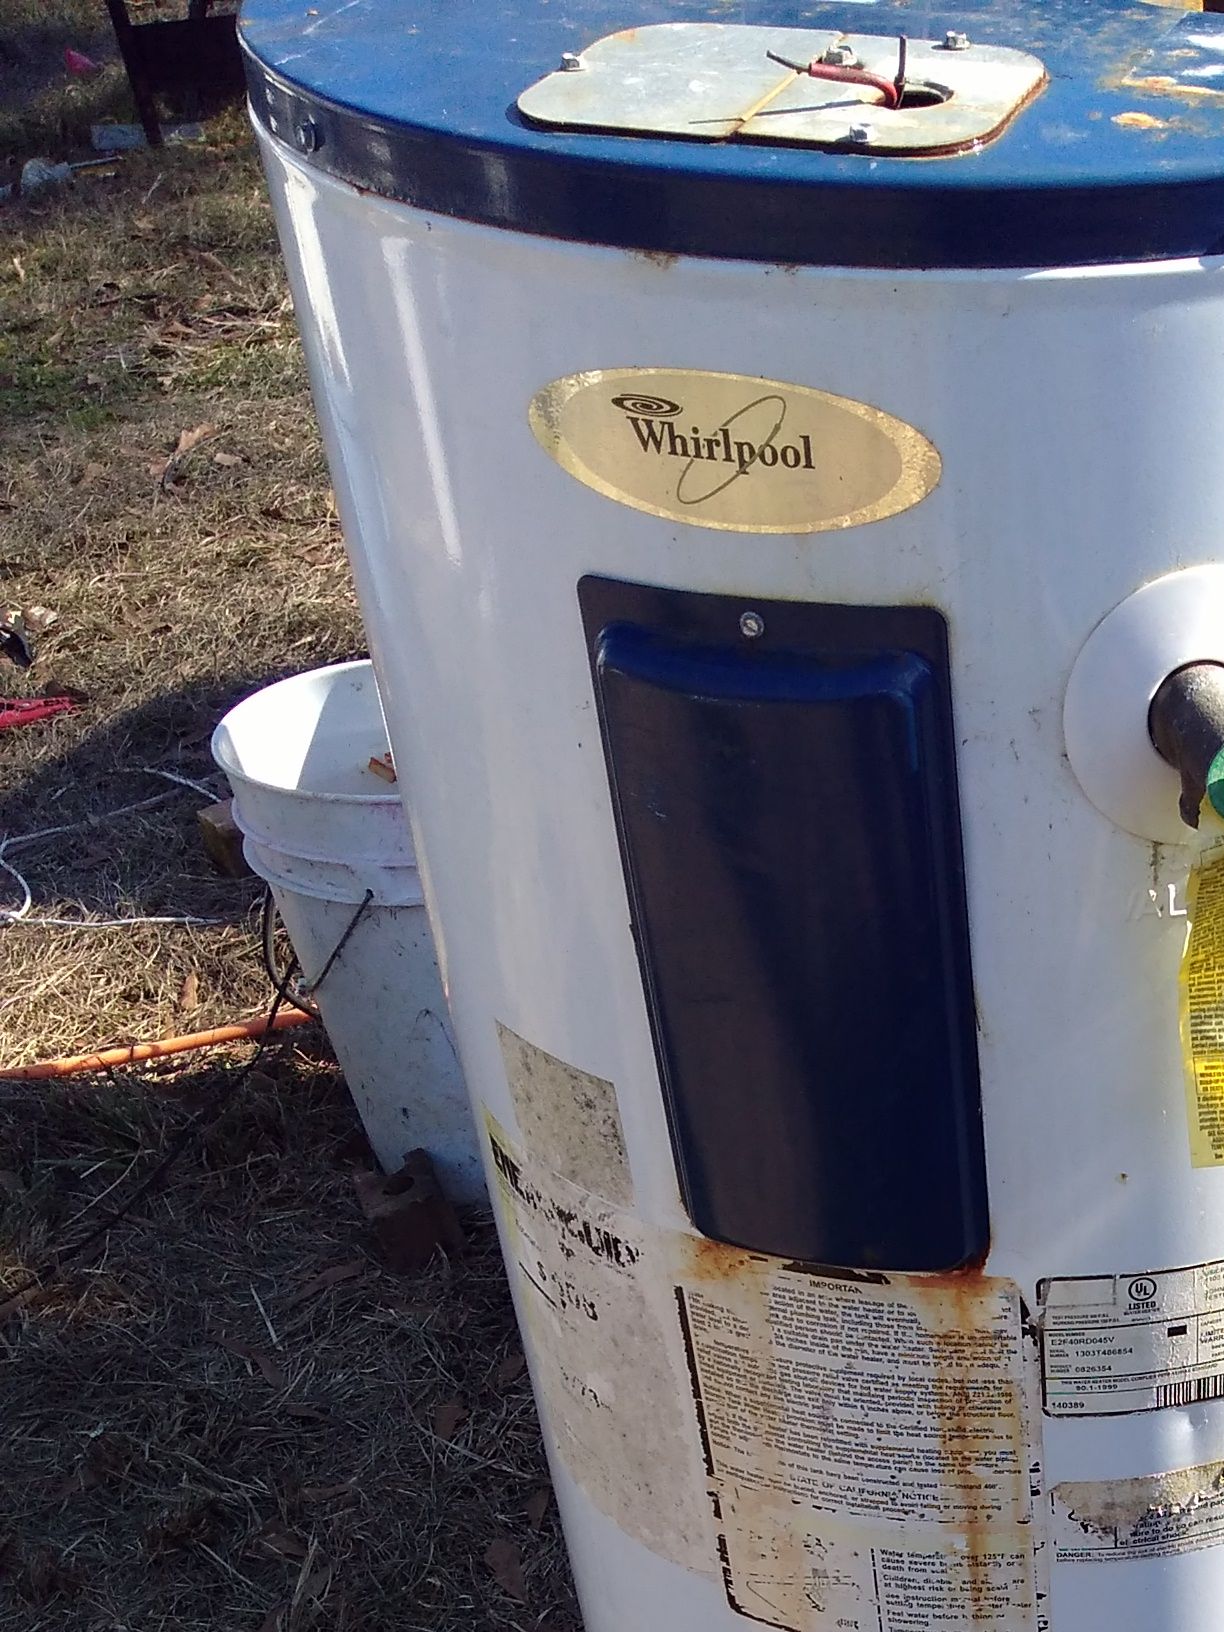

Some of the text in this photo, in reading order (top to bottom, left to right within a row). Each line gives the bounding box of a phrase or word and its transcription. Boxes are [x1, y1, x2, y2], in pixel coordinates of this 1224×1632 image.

[626, 415, 815, 475] Whirlpool
[842, 1304, 861, 1313] water
[862, 1305, 884, 1315] heater
[1128, 1300, 1157, 1311] LISTED
[841, 1351, 859, 1360] water
[866, 1371, 895, 1382] required
[1051, 1401, 1085, 1409] 140389
[880, 1549, 903, 1558] Water
[881, 1557, 905, 1565] cause
[908, 1559, 936, 1567] severe
[882, 1564, 905, 1573] death
[895, 1582, 925, 1592] highest
[903, 1593, 947, 1603] instruction
[932, 1612, 958, 1620] before
